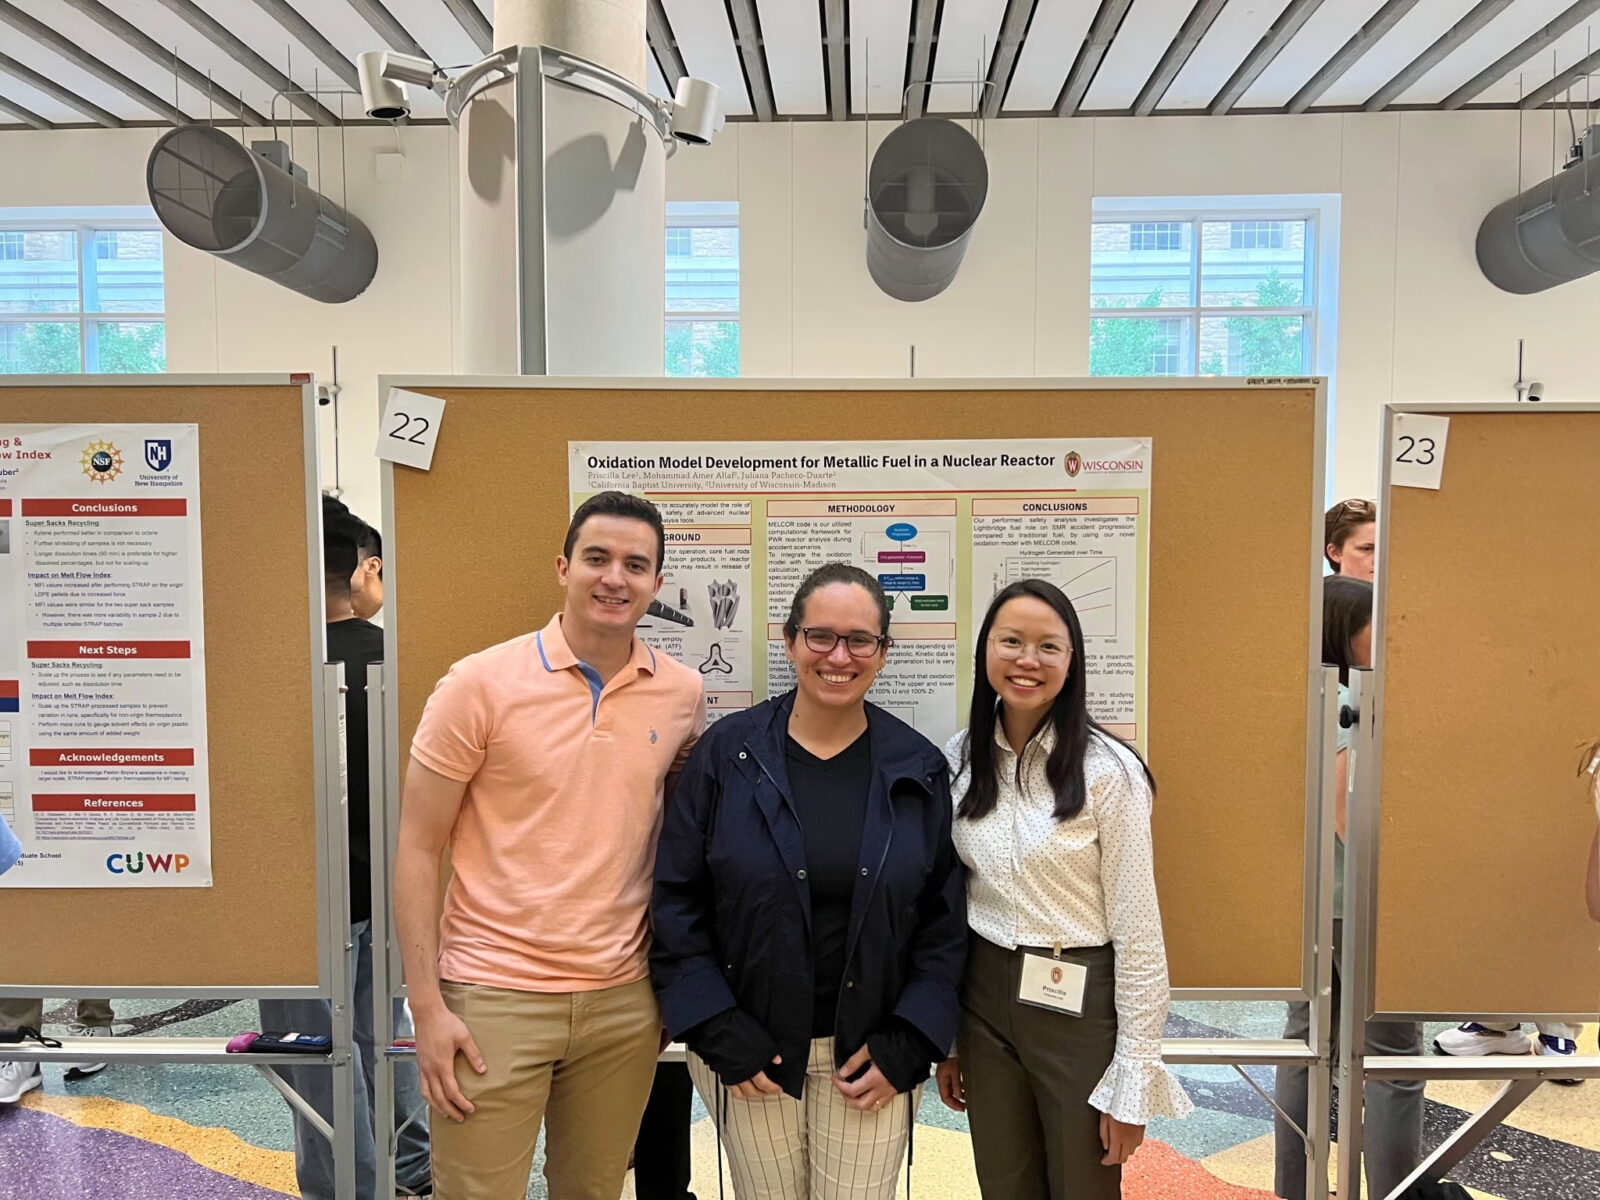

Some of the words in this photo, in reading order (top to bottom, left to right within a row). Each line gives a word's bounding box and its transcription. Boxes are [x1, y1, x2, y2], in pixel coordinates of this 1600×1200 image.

[389, 412, 429, 445] 22
[14, 438, 22, 446] &
[149, 446, 166, 460] NH
[1396, 436, 1435, 464] 23
[17, 451, 51, 459] Index
[92, 457, 110, 466] NSF
[588, 456, 655, 468] Oxidation
[659, 456, 702, 468] Model
[706, 456, 797, 471] Development
[801, 456, 820, 467] for
[824, 455, 878, 467] Metallic
[882, 455, 911, 467] Fuel
[914, 455, 927, 467] in
[931, 458, 938, 467] a
[943, 455, 997, 467] Nuclear
[1001, 455, 1054, 466] Reactor
[1082, 461, 1143, 470] WISCONSIN
[632, 481, 659, 490] Baptist
[72, 504, 137, 512] Conclusions
[79, 646, 103, 654] Next
[107, 646, 137, 656] Steps
[60, 754, 164, 763] Acknowledgements
[84, 799, 143, 807] References
[1043, 986, 1066, 996] Priscilla
